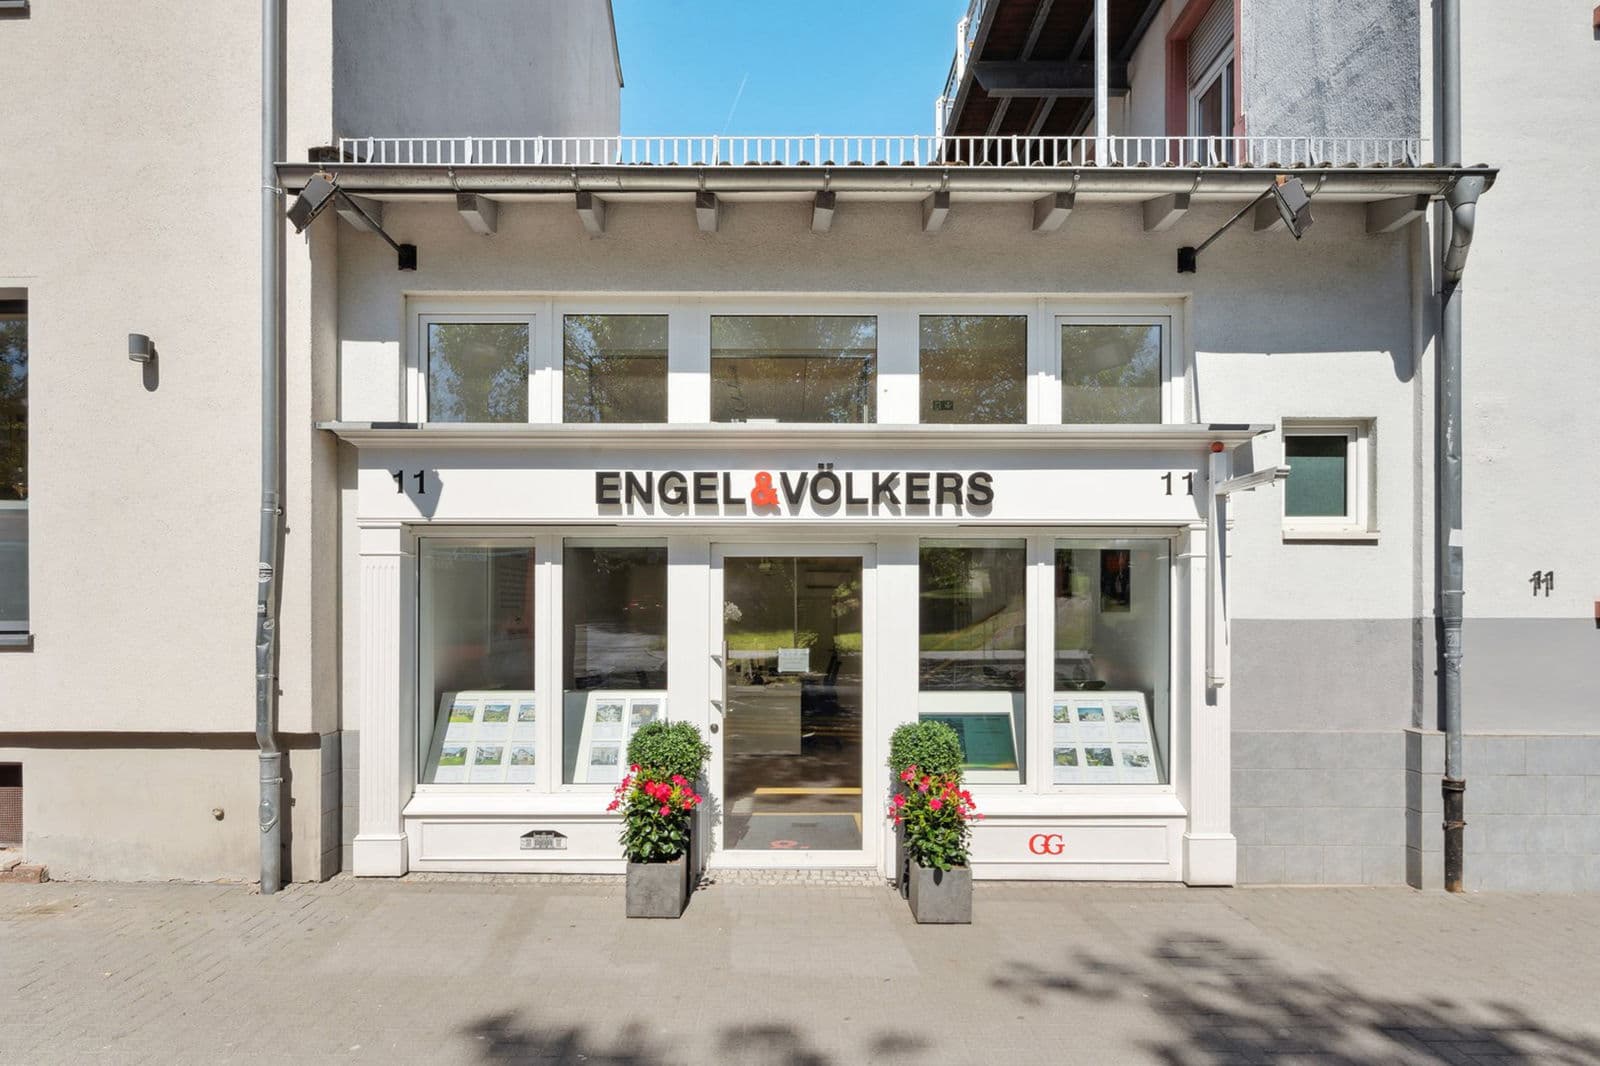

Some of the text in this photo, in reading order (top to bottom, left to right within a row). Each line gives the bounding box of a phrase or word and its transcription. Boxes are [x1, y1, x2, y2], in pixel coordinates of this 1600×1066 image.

[393, 470, 425, 494] 11
[595, 463, 994, 507] ENGEL&VÖLKERS
[1161, 471, 1194, 496] 11
[1530, 571, 1554, 593] 11
